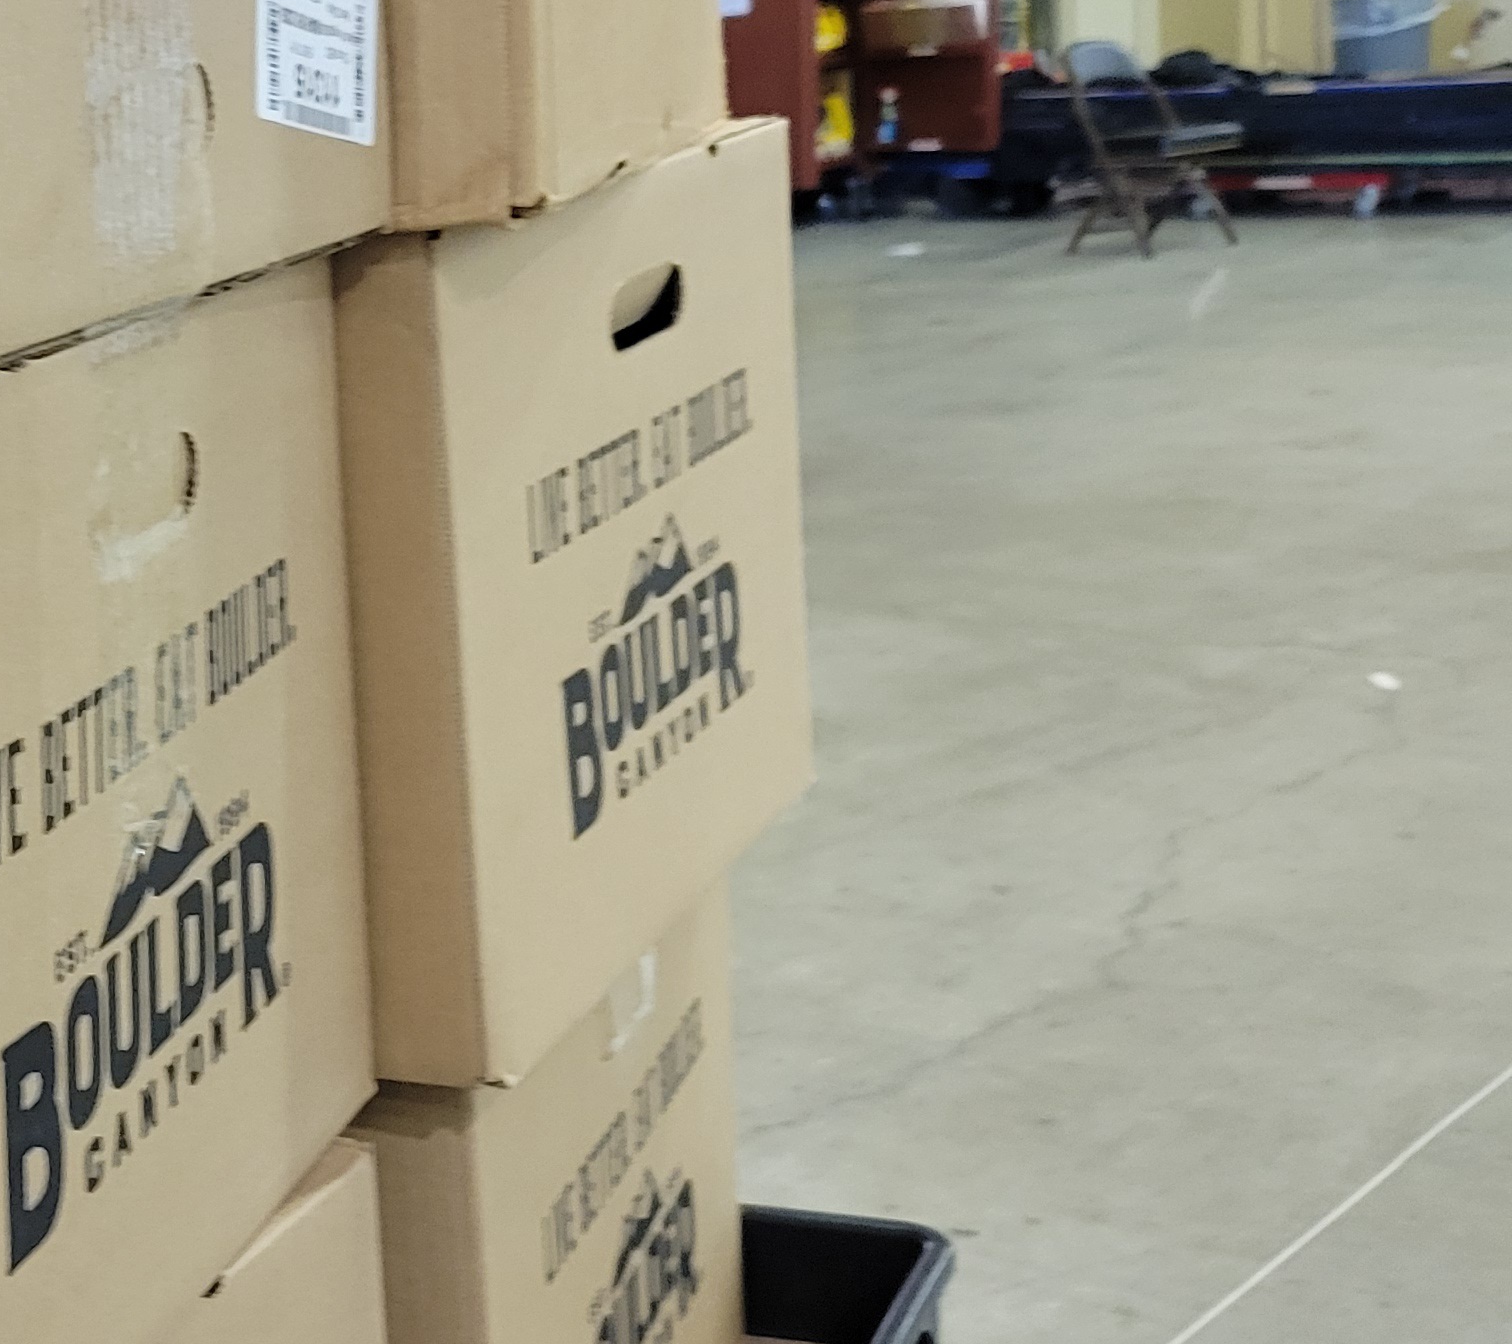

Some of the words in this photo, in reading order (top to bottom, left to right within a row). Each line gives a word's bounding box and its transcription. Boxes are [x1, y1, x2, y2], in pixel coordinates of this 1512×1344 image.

[561, 561, 745, 840] BOULDER
[0, 820, 282, 1276] BOULDER
[84, 1009, 228, 1194] CANYON
